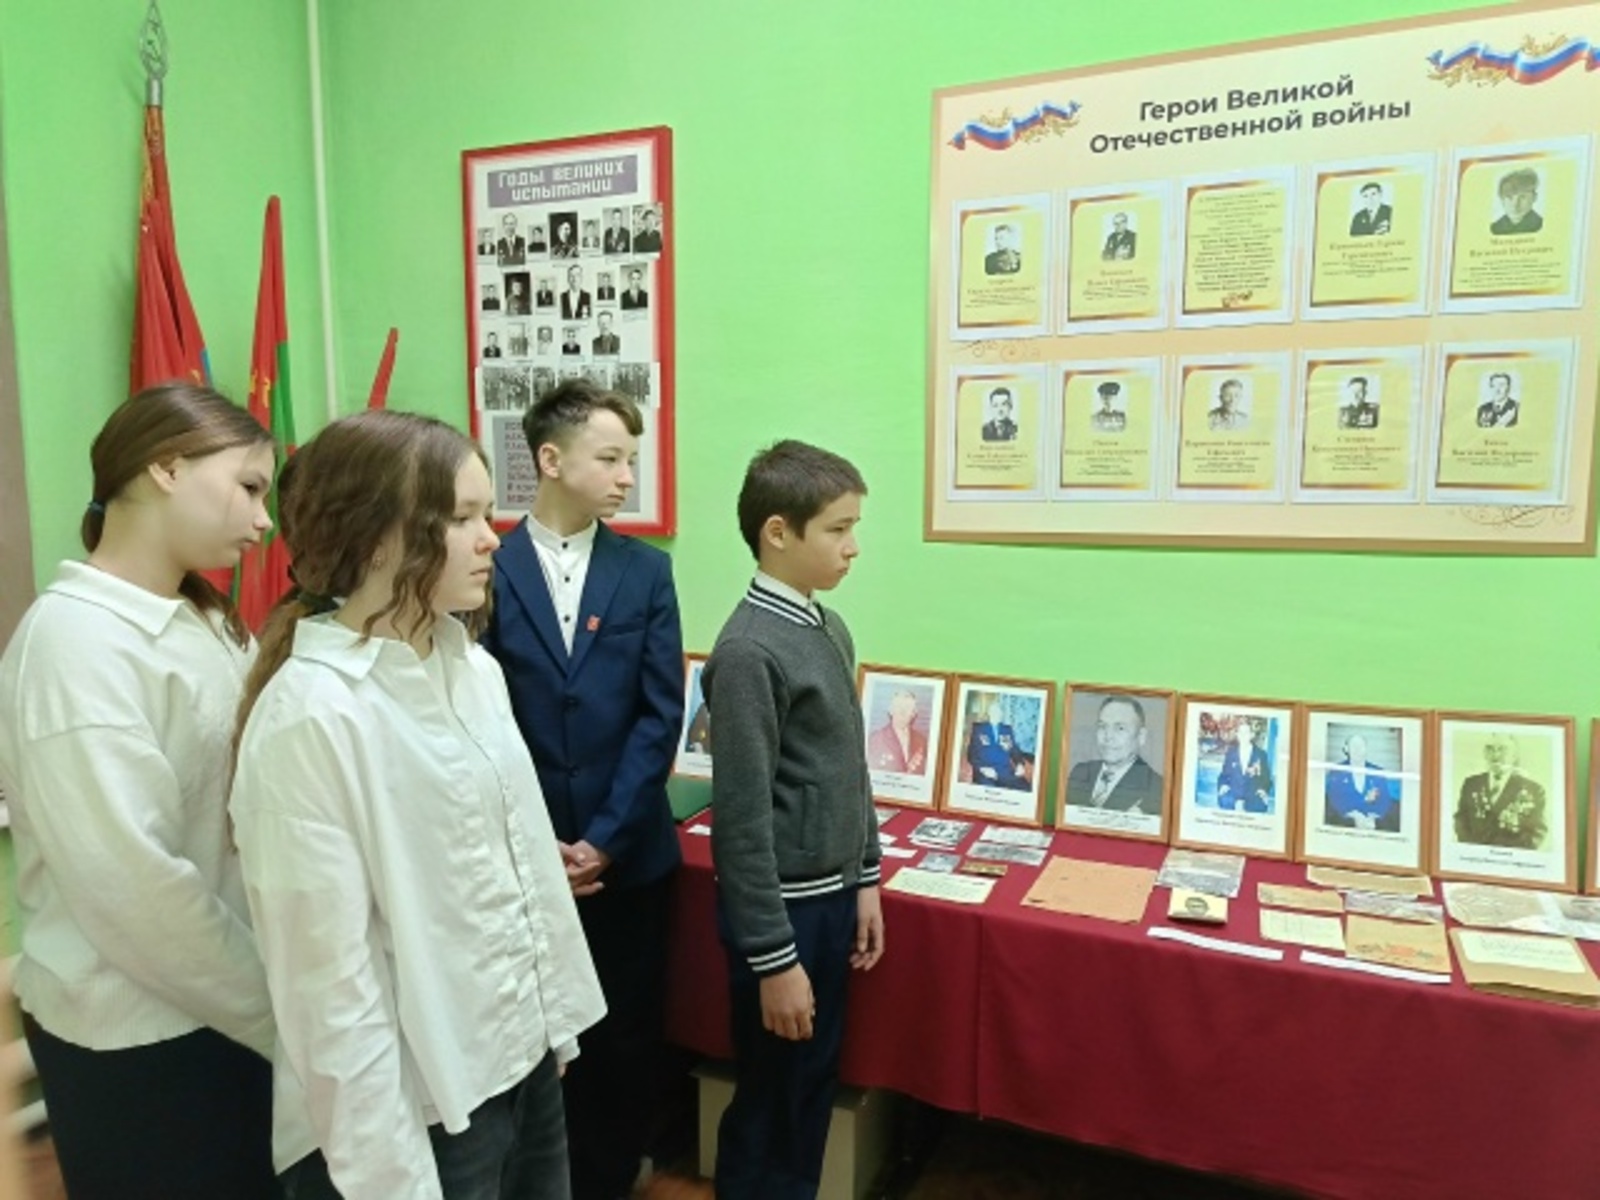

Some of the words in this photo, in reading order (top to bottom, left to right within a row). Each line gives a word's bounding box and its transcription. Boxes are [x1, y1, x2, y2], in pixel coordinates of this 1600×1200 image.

[1139, 96, 1218, 123] Герои
[1227, 75, 1354, 111] Великой
[1089, 110, 1303, 154] Отечественной
[1311, 100, 1412, 129] войны
